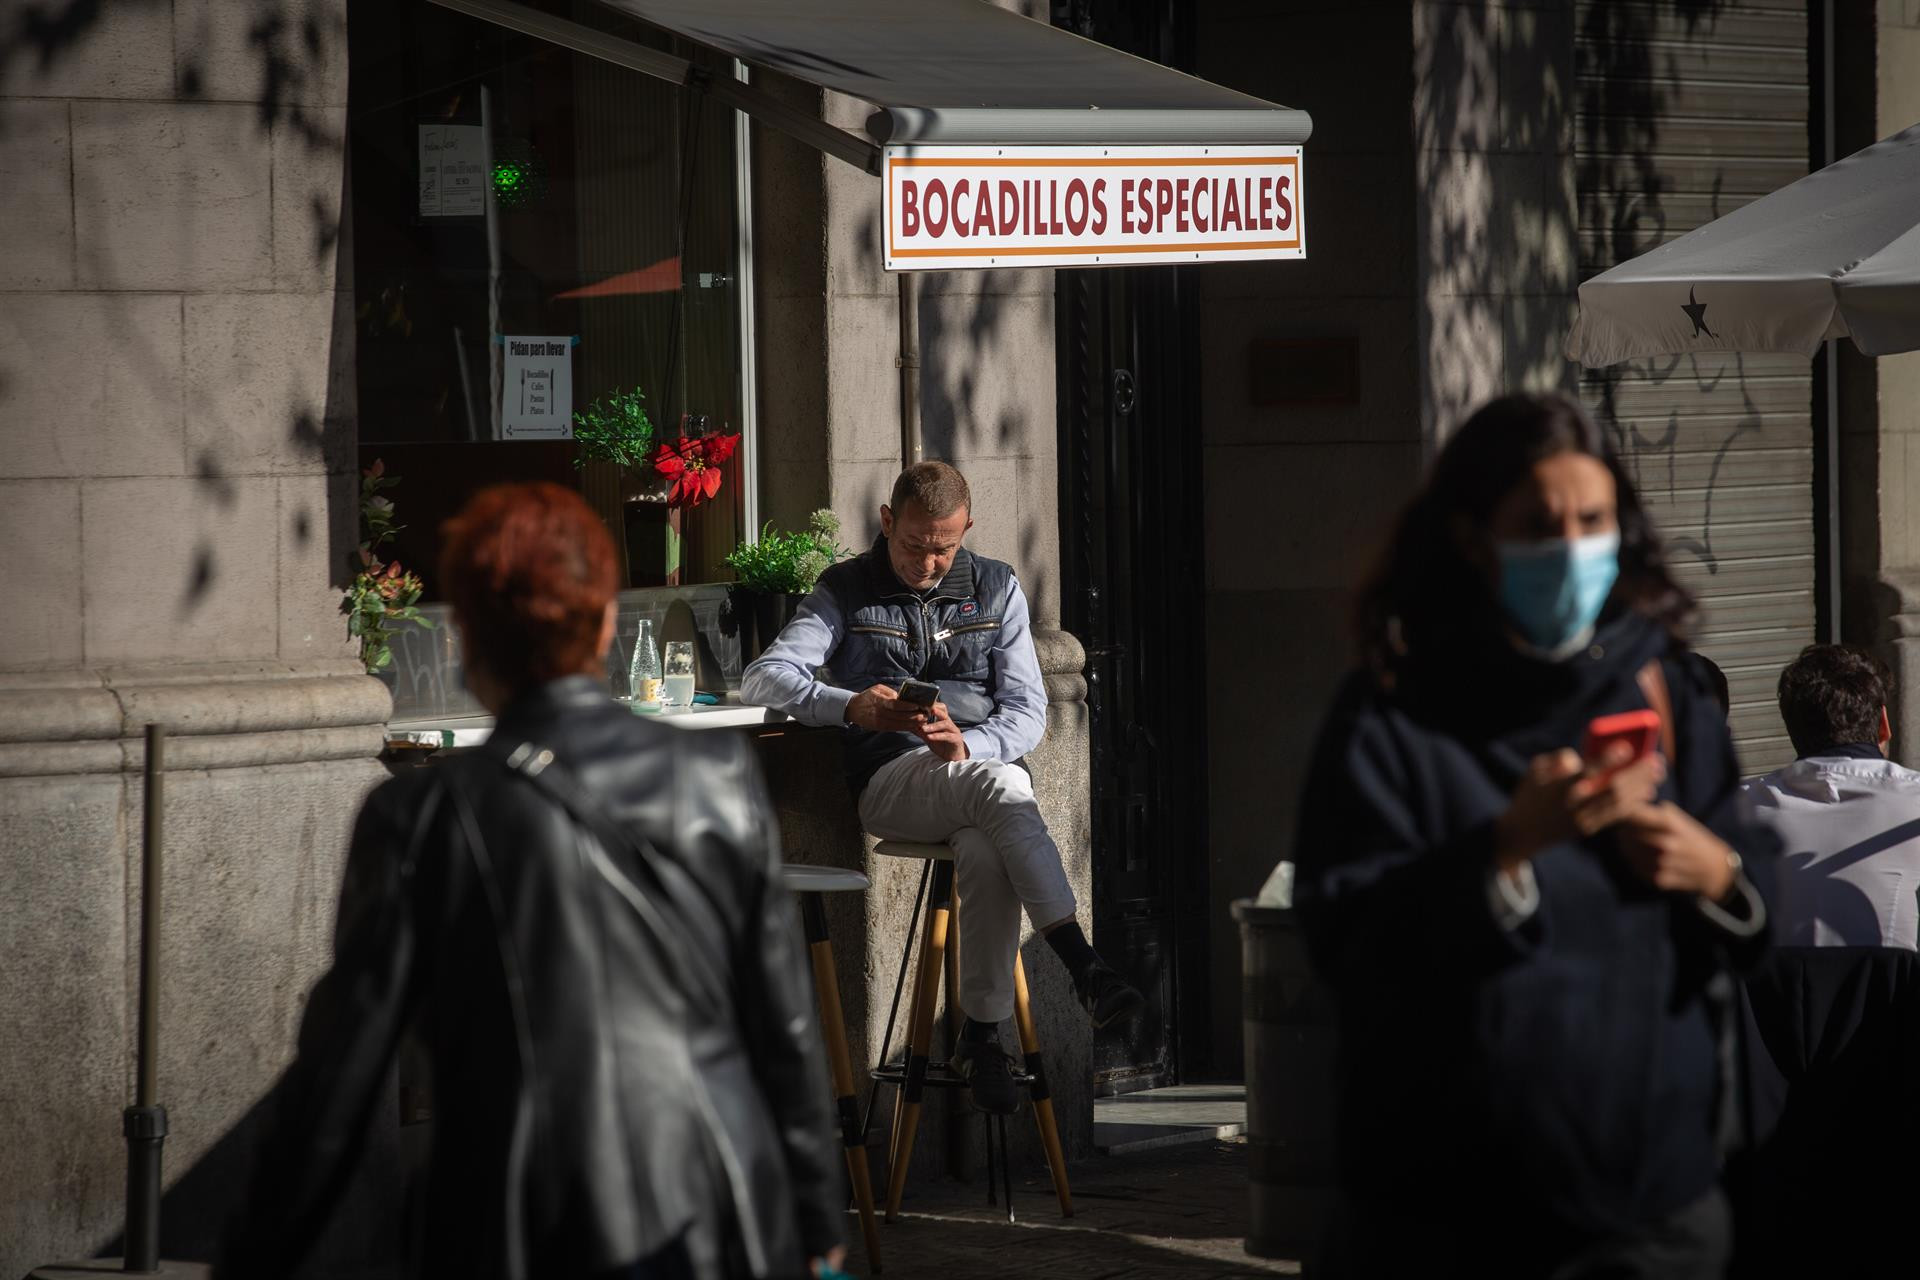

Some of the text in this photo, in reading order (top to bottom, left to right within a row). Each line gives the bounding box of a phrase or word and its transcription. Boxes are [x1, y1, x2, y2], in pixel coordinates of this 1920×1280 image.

[901, 175, 1293, 238] BOCADILLOS ESPECIALES
[510, 341, 565, 358] Pidan para llevar
